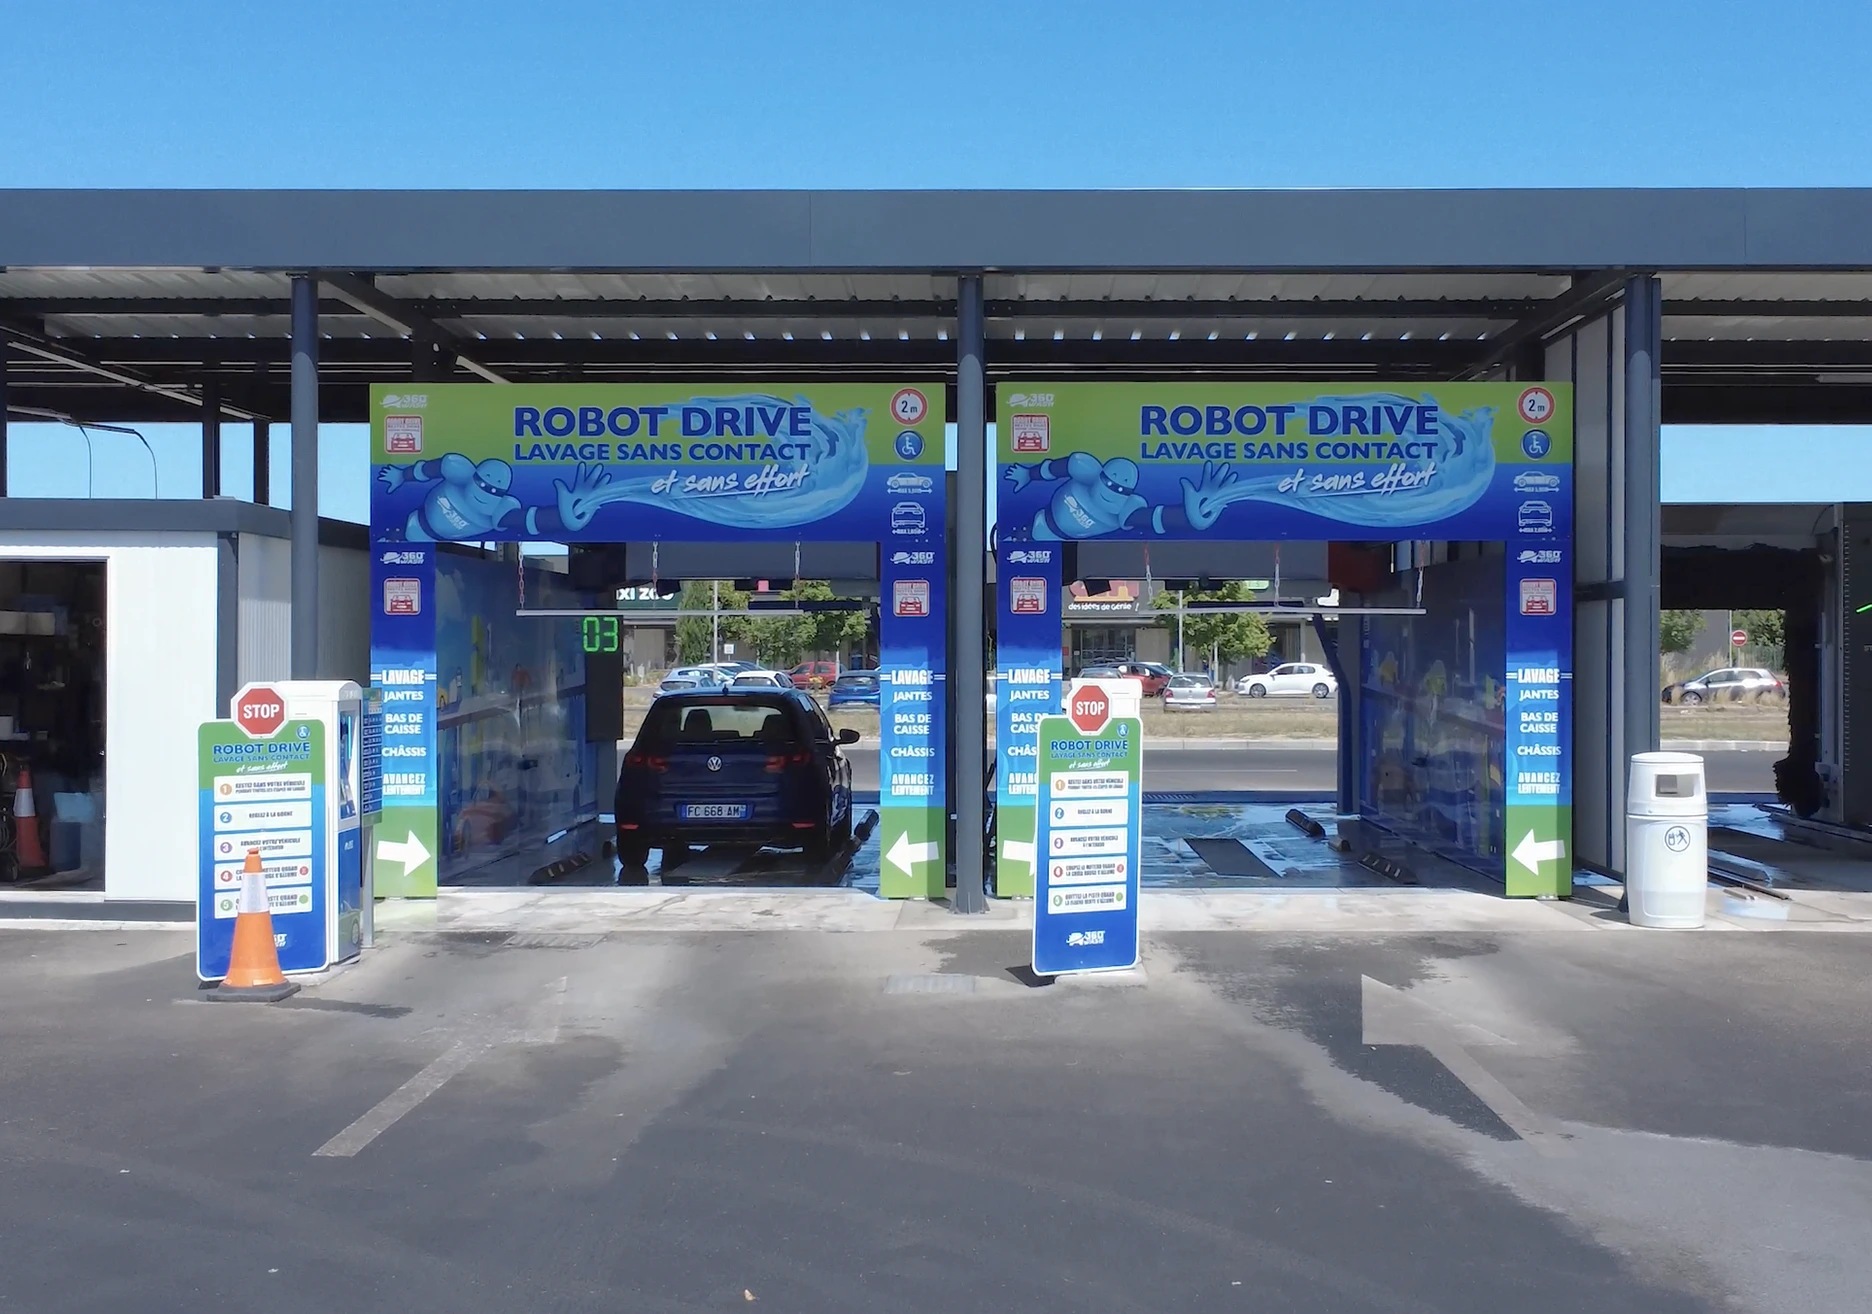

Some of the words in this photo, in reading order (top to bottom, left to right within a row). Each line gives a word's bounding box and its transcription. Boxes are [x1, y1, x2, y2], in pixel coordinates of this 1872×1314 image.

[902, 400, 908, 412] 2
[1528, 399, 1536, 412] 2
[514, 406, 669, 437] ROBOT
[682, 406, 812, 437] DRIVE
[1141, 406, 1295, 436] ROBOT
[1308, 406, 1439, 436] DRIVE
[514, 443, 610, 461] LAVAGE
[617, 443, 682, 461] SANS
[689, 443, 811, 461] CONTACT
[1141, 442, 1236, 460] LAVAGE
[1244, 442, 1308, 460] SANS
[1316, 442, 1438, 460] CONTACT
[651, 470, 679, 495] et
[683, 471, 741, 492] sans
[744, 464, 811, 496] effort
[1278, 468, 1306, 493] et
[1310, 470, 1366, 492] sans
[1370, 462, 1437, 496] effort
[1101, 603, 1110, 611] de
[583, 616, 618, 652] 03
[382, 670, 424, 684] LAVAGE
[892, 670, 934, 684] LAVAGE
[1008, 669, 1050, 684] LAVAGE
[1518, 668, 1560, 684] LAVAGE
[384, 691, 424, 703] JANTES
[893, 692, 932, 703] JANTES
[1010, 690, 1050, 702] JANTES
[1519, 690, 1559, 702] JANTES
[243, 704, 280, 719] STOP
[1076, 701, 1105, 716] STOP
[386, 714, 406, 722] BAS
[408, 714, 423, 722] DE
[894, 714, 916, 723] BAS
[917, 714, 932, 723] DE
[1012, 713, 1032, 722] BAS
[1521, 712, 1542, 722] BAS
[1544, 712, 1558, 722] DE
[384, 725, 422, 734] CAISSE
[894, 725, 930, 734] CAISSE
[1520, 724, 1557, 733] CAISSE
[213, 744, 264, 755] ROBOT
[268, 742, 310, 753] DRIVE
[382, 744, 426, 757] CHÂSSIS
[890, 745, 935, 757] CHÂSSIS
[1051, 741, 1092, 750] ROBOT
[1095, 740, 1128, 750] DRIVE
[1517, 744, 1562, 756] CHÂSSIS
[383, 774, 426, 784] AVANCEZ
[892, 774, 934, 784] AVANCEZ
[1518, 772, 1560, 783] AVANCEZ
